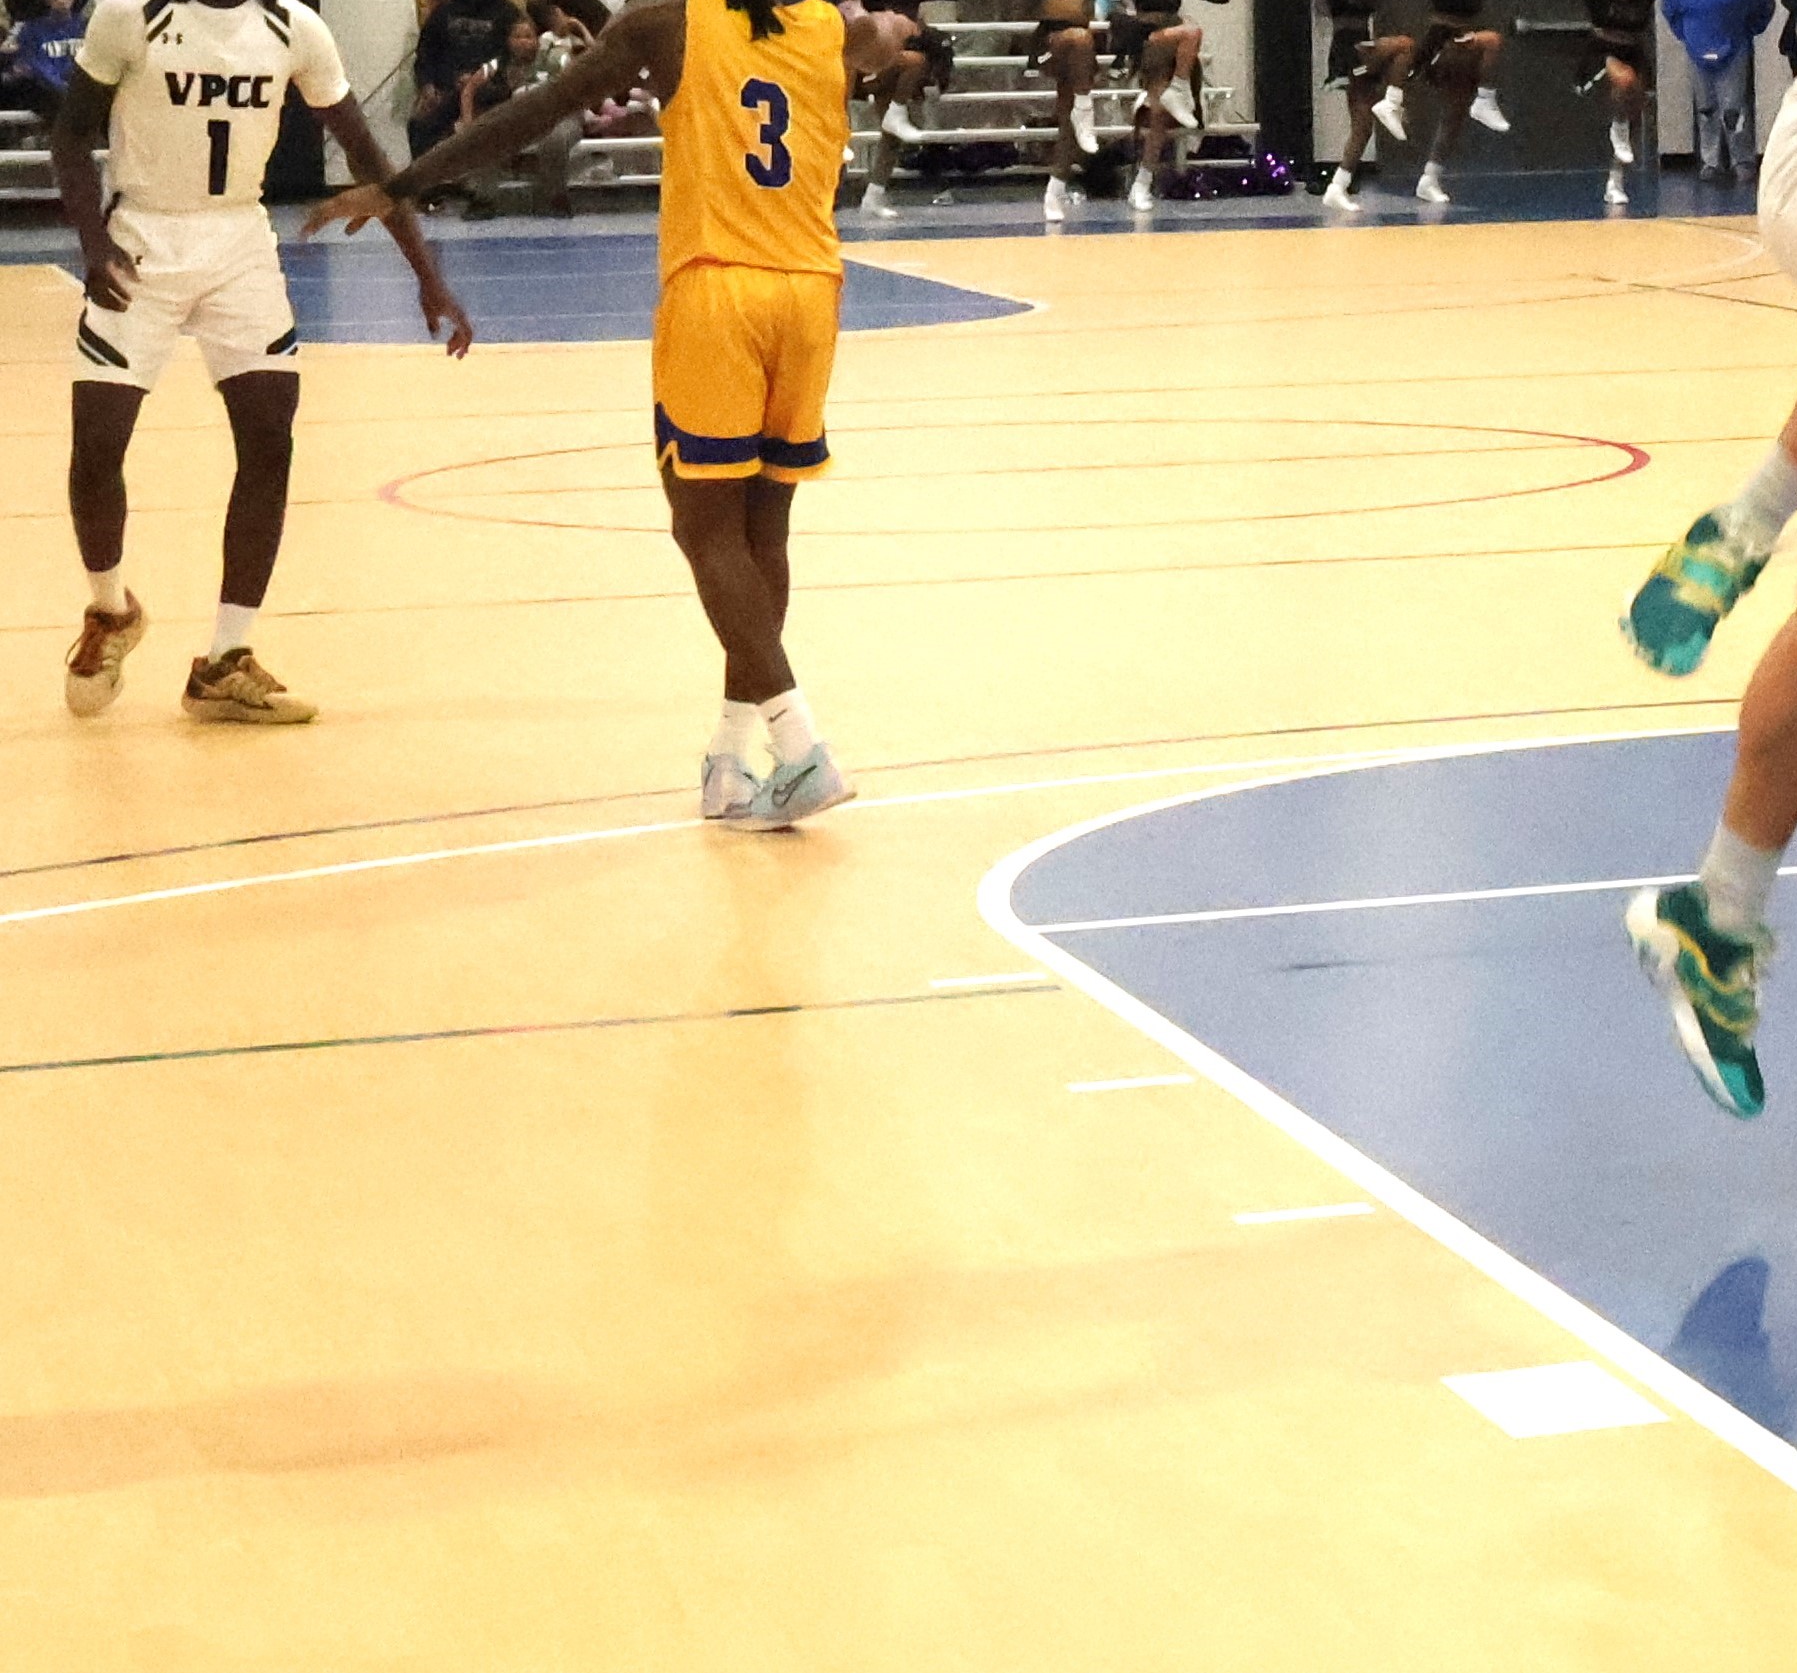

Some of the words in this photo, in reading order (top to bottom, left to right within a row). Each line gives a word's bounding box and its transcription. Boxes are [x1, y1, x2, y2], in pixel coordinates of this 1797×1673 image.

[164, 71, 274, 108] VPCC
[207, 118, 231, 195] 1
[740, 78, 792, 188] 3
